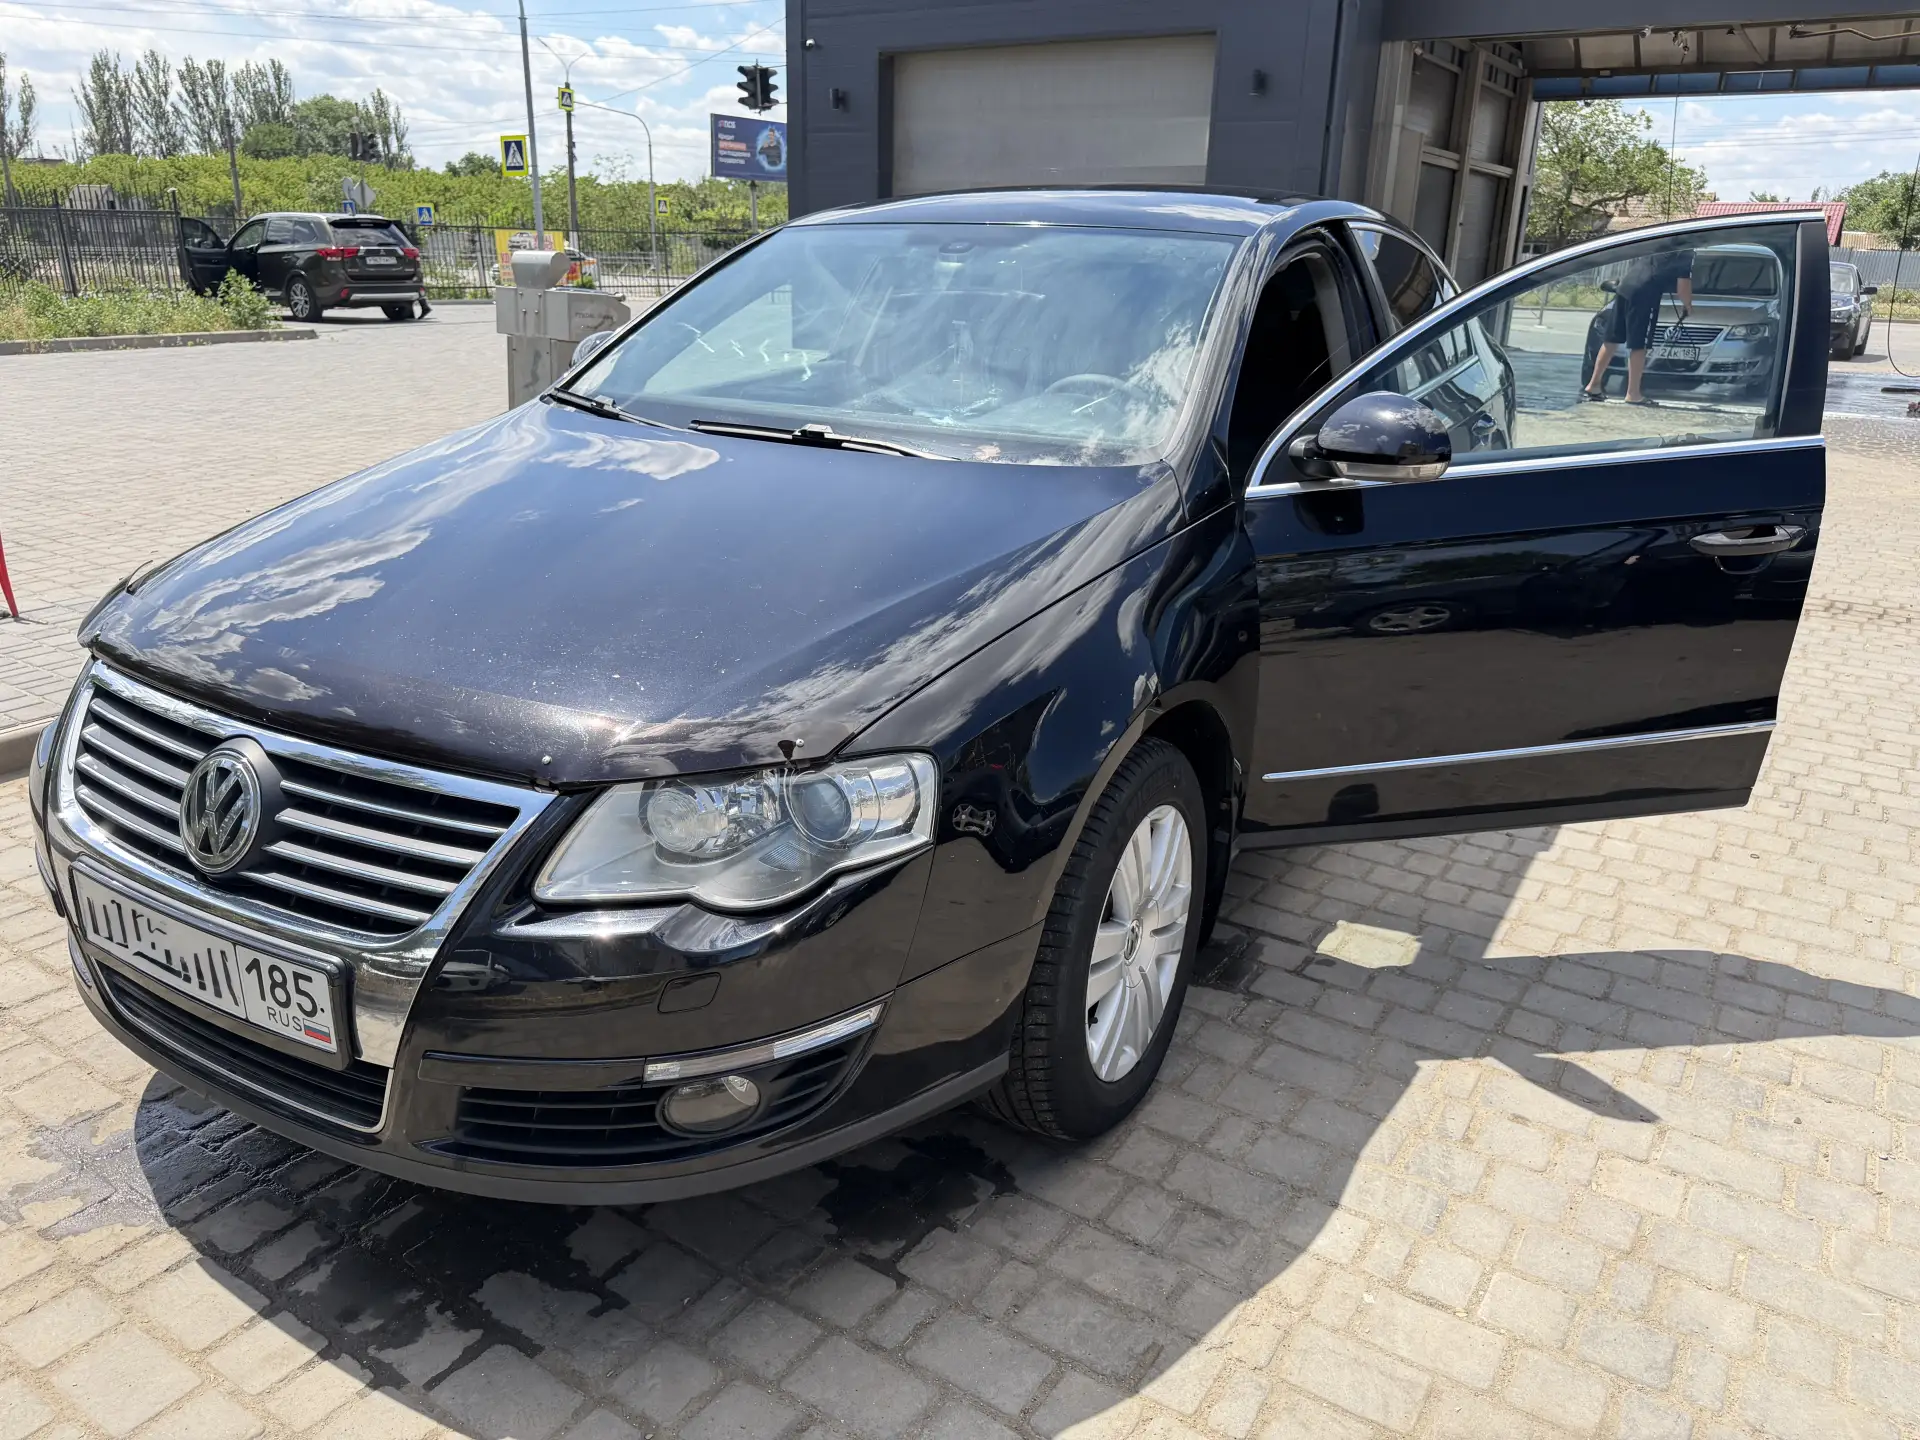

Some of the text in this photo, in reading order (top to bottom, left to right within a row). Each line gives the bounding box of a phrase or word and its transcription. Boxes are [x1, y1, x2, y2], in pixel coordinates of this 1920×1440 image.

[182, 752, 257, 870] VW
[245, 957, 318, 1018] 185
[267, 1006, 302, 1032] RUS
